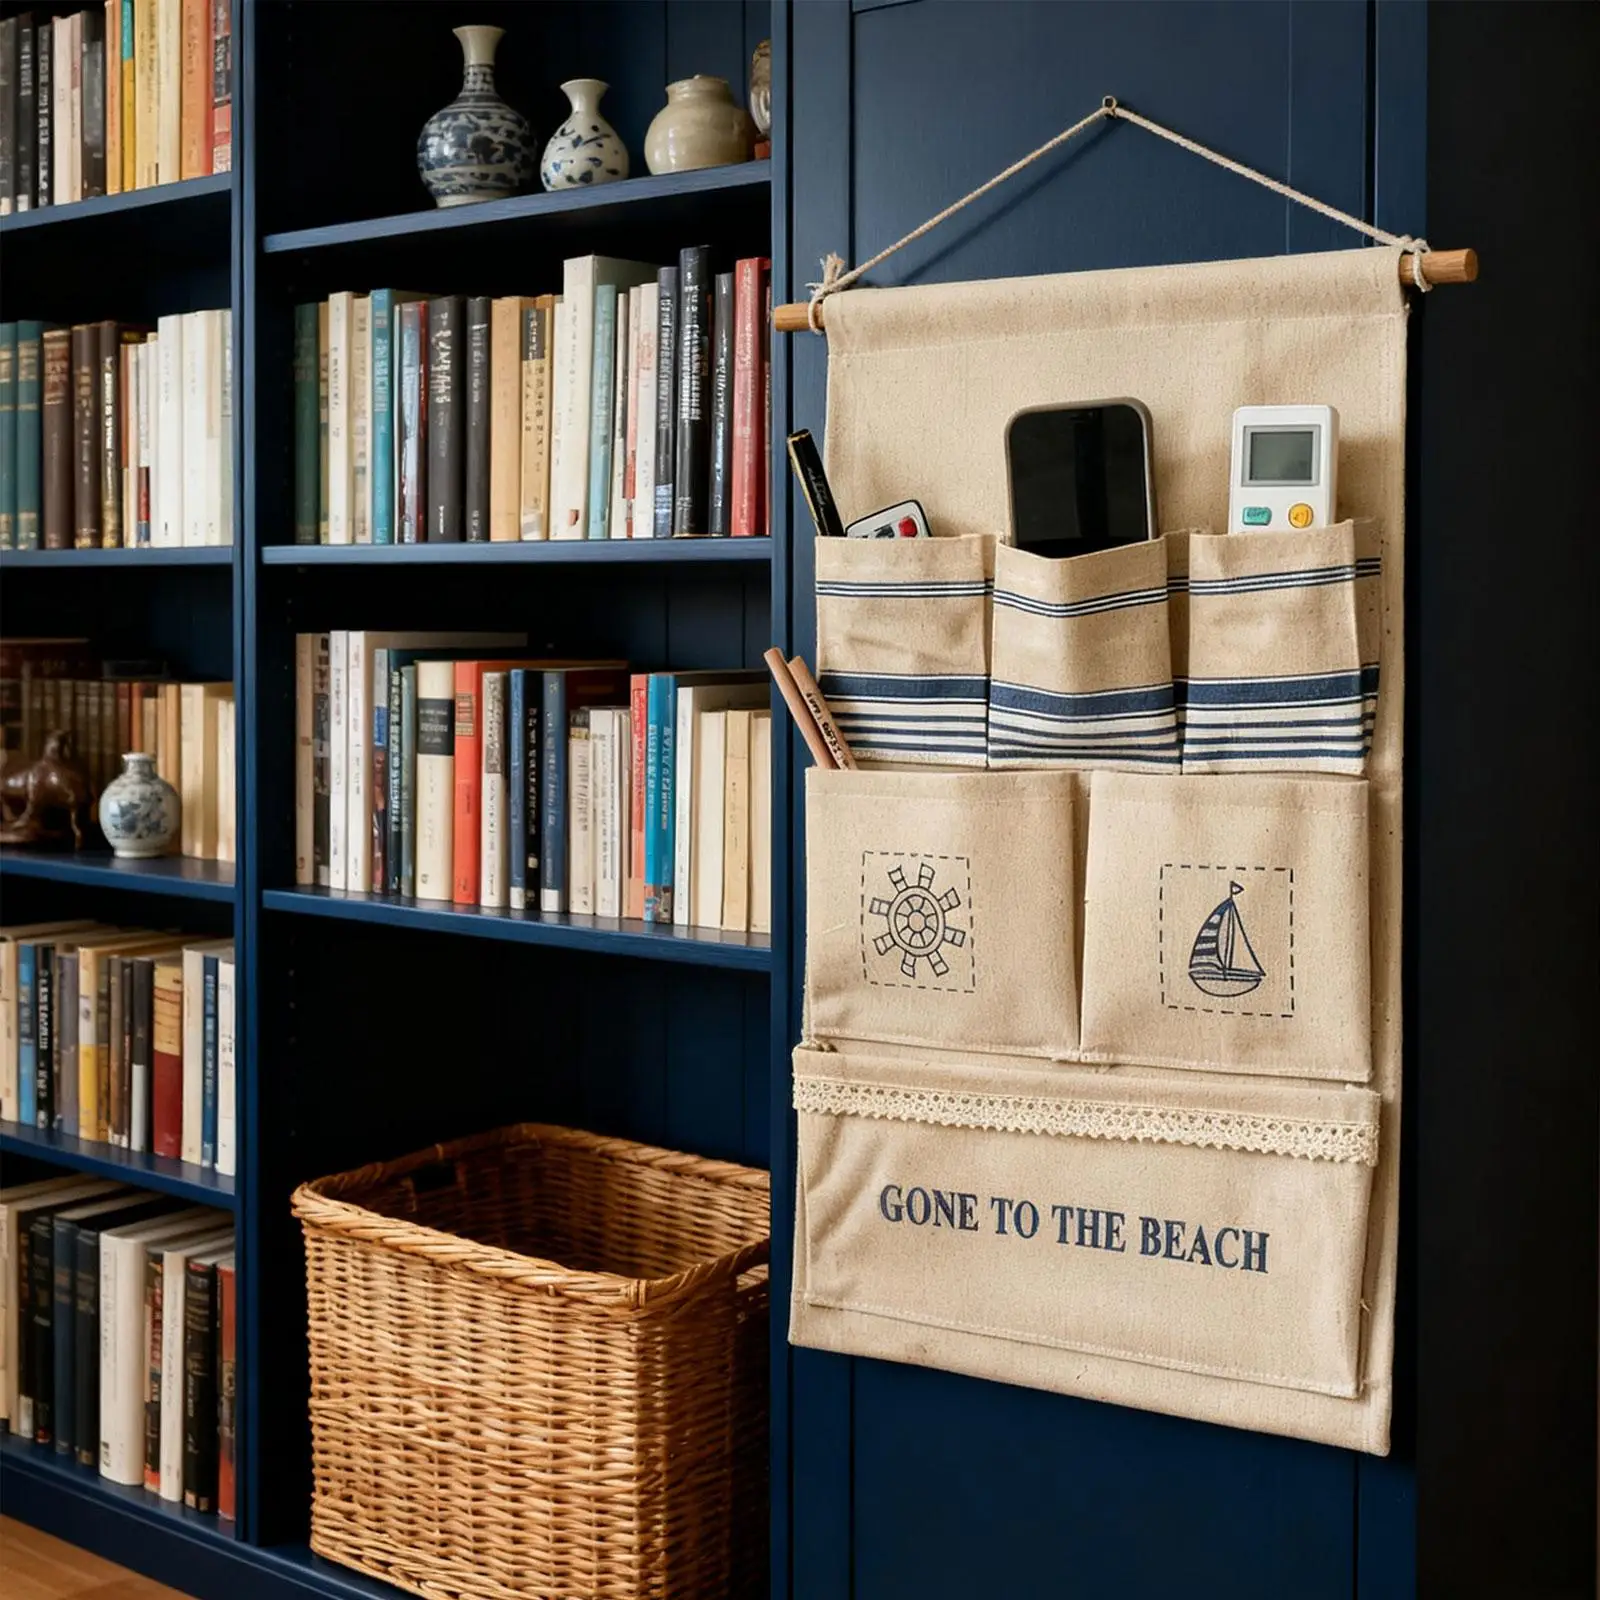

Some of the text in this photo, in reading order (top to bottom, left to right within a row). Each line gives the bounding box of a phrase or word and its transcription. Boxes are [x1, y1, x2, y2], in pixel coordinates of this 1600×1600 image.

[879, 1184, 1270, 1273] GONE TO THE BEACH
